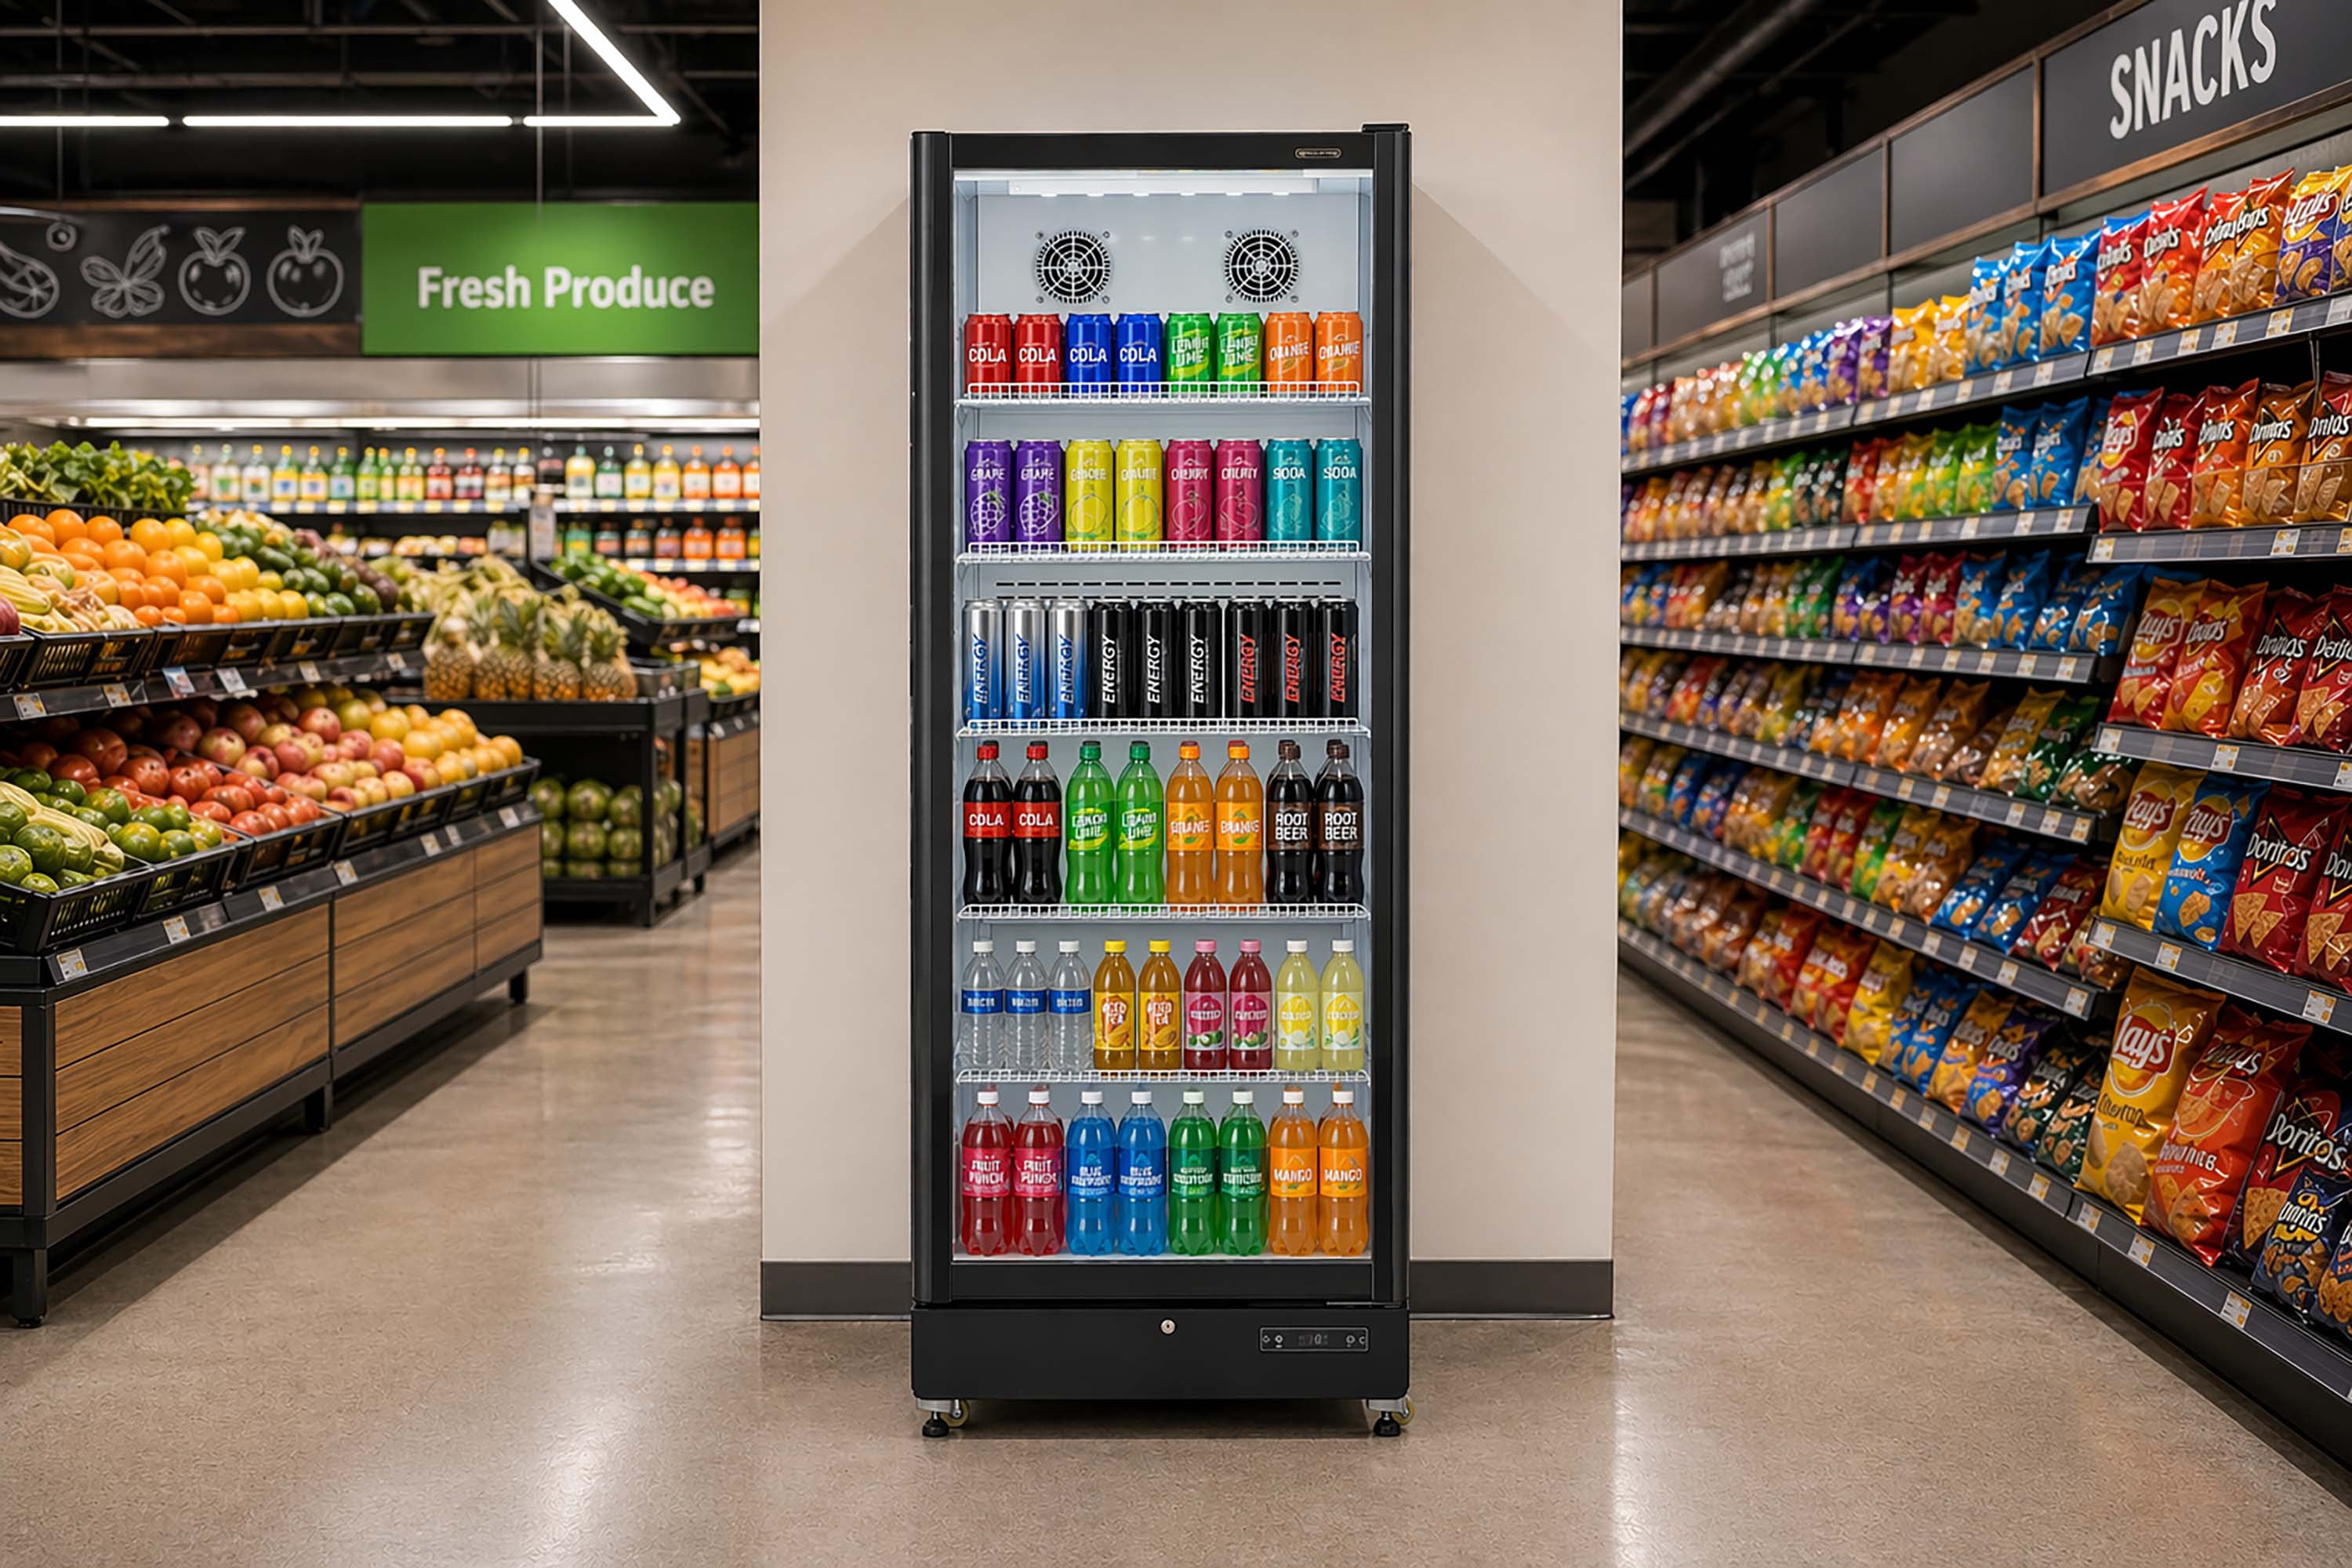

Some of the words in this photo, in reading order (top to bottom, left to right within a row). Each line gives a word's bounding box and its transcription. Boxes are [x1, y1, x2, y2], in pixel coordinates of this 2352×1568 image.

[2110, 0, 2277, 139] SNACKS
[418, 264, 531, 308] Fresh
[544, 264, 715, 308] Produce
[968, 347, 1007, 363] COLA
[1018, 347, 1057, 363] COLA
[1069, 347, 1108, 363] COLA
[1120, 347, 1157, 363] COLA
[970, 468, 1006, 481] GRAPE
[1272, 467, 1306, 480] SODA
[1323, 466, 1357, 480] SODA
[1102, 633, 1116, 703] ENERGY
[1147, 633, 1161, 703] ENERGY
[1190, 633, 1205, 703] ENERGY
[968, 813, 1004, 826] COLA
[1018, 813, 1054, 826] COLA
[1275, 812, 1308, 826] ROOT
[1324, 811, 1358, 826] ROOT
[1275, 827, 1308, 840] BEER
[1324, 827, 1358, 840] BEER
[2245, 833, 2311, 872] Doritos
[2266, 1113, 2347, 1171] Doritos
[1324, 1168, 1363, 1182] MANGO
